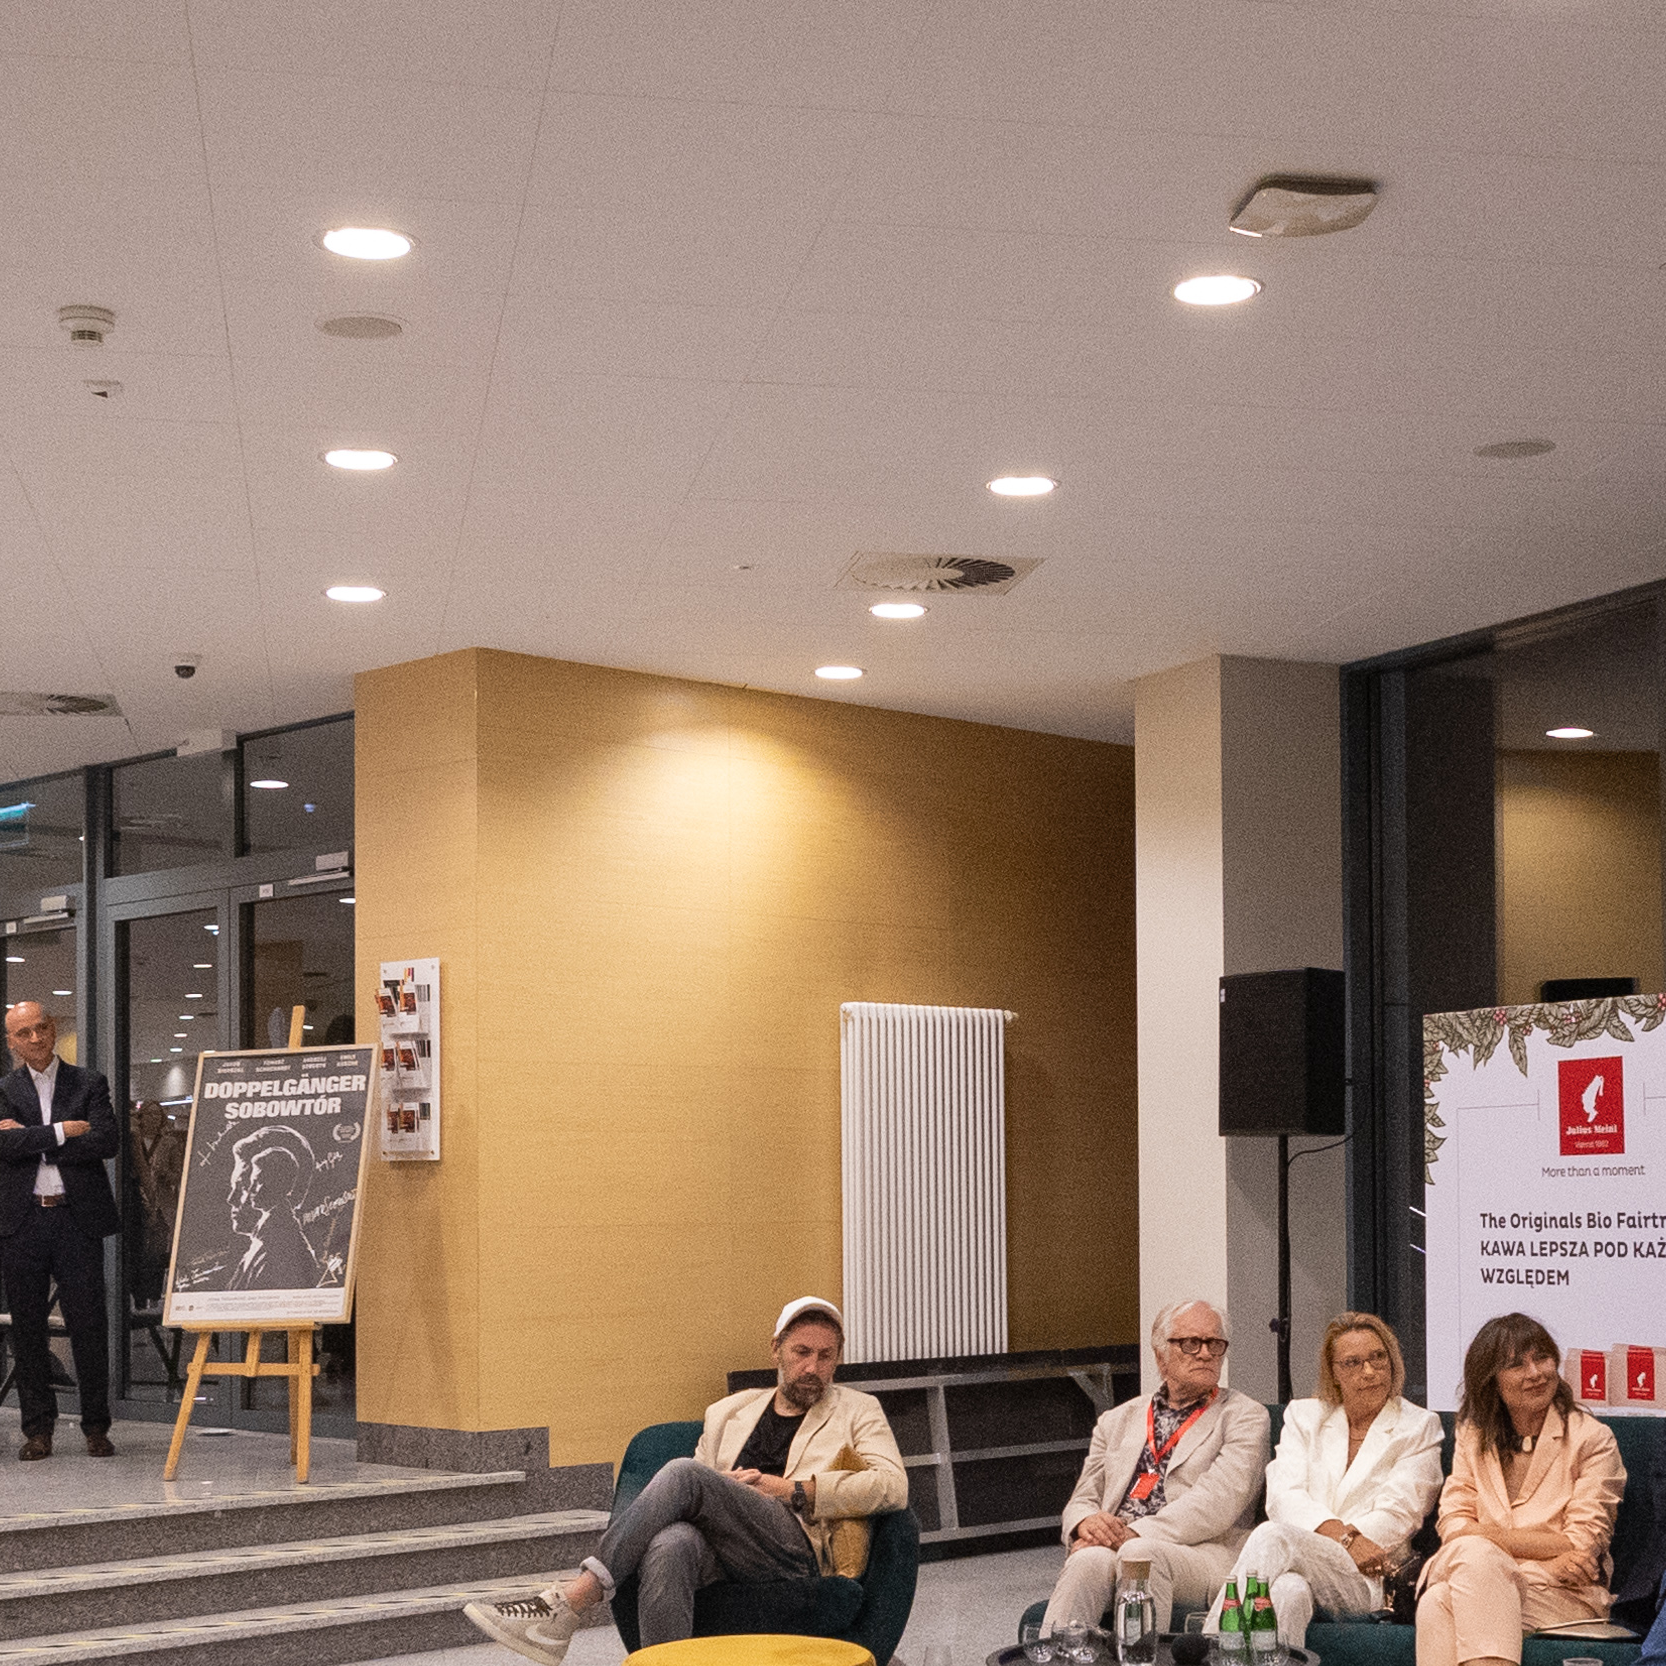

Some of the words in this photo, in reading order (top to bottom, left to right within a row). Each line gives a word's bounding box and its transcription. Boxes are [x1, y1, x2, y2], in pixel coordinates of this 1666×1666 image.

[204, 1073, 367, 1099] DOPPELGÄNGER
[224, 1095, 342, 1119] SOBOWTÓR
[1542, 1167, 1566, 1177] More
[1568, 1166, 1591, 1177] than
[1594, 1167, 1600, 1176] a
[1602, 1165, 1645, 1176] moment
[1480, 1212, 1507, 1230] The
[1511, 1212, 1583, 1233] Originals
[1587, 1212, 1612, 1230] Bio
[1480, 1240, 1526, 1257] KAWA
[1531, 1240, 1589, 1258] LEPSZA
[1593, 1241, 1628, 1258] POD
[1480, 1267, 1570, 1288] WZGLĘDEM
